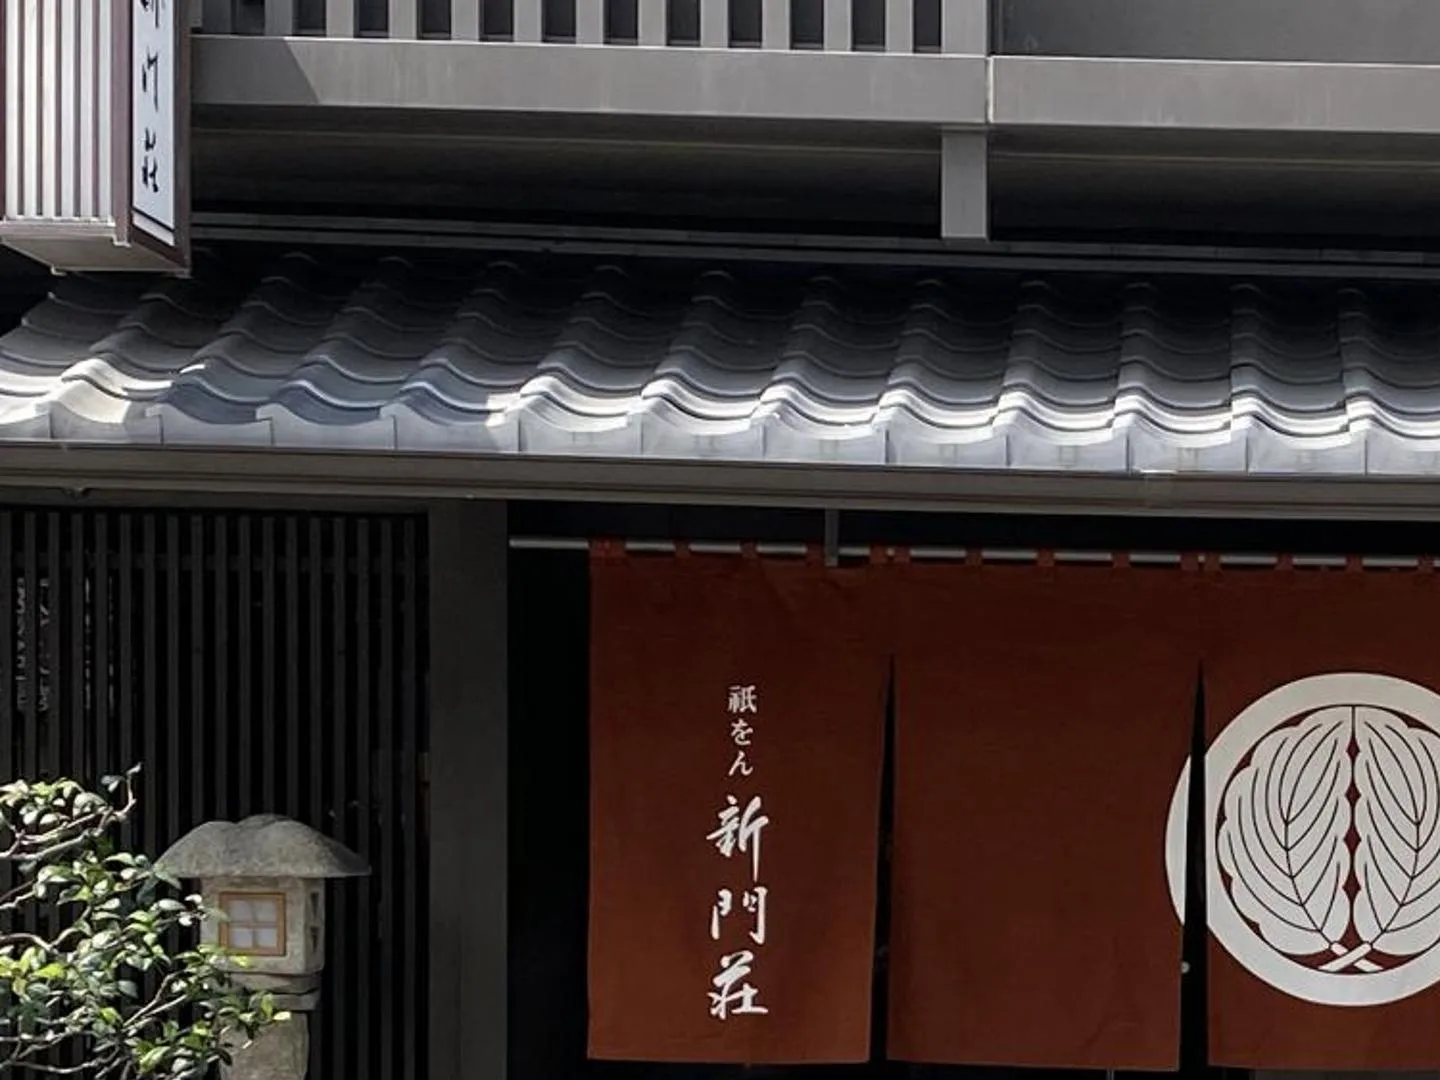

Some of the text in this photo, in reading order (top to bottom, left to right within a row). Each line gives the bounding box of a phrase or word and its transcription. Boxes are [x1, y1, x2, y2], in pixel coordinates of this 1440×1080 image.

[141, 0, 163, 193] 門荘
[706, 795, 770, 1020] 新門荘
